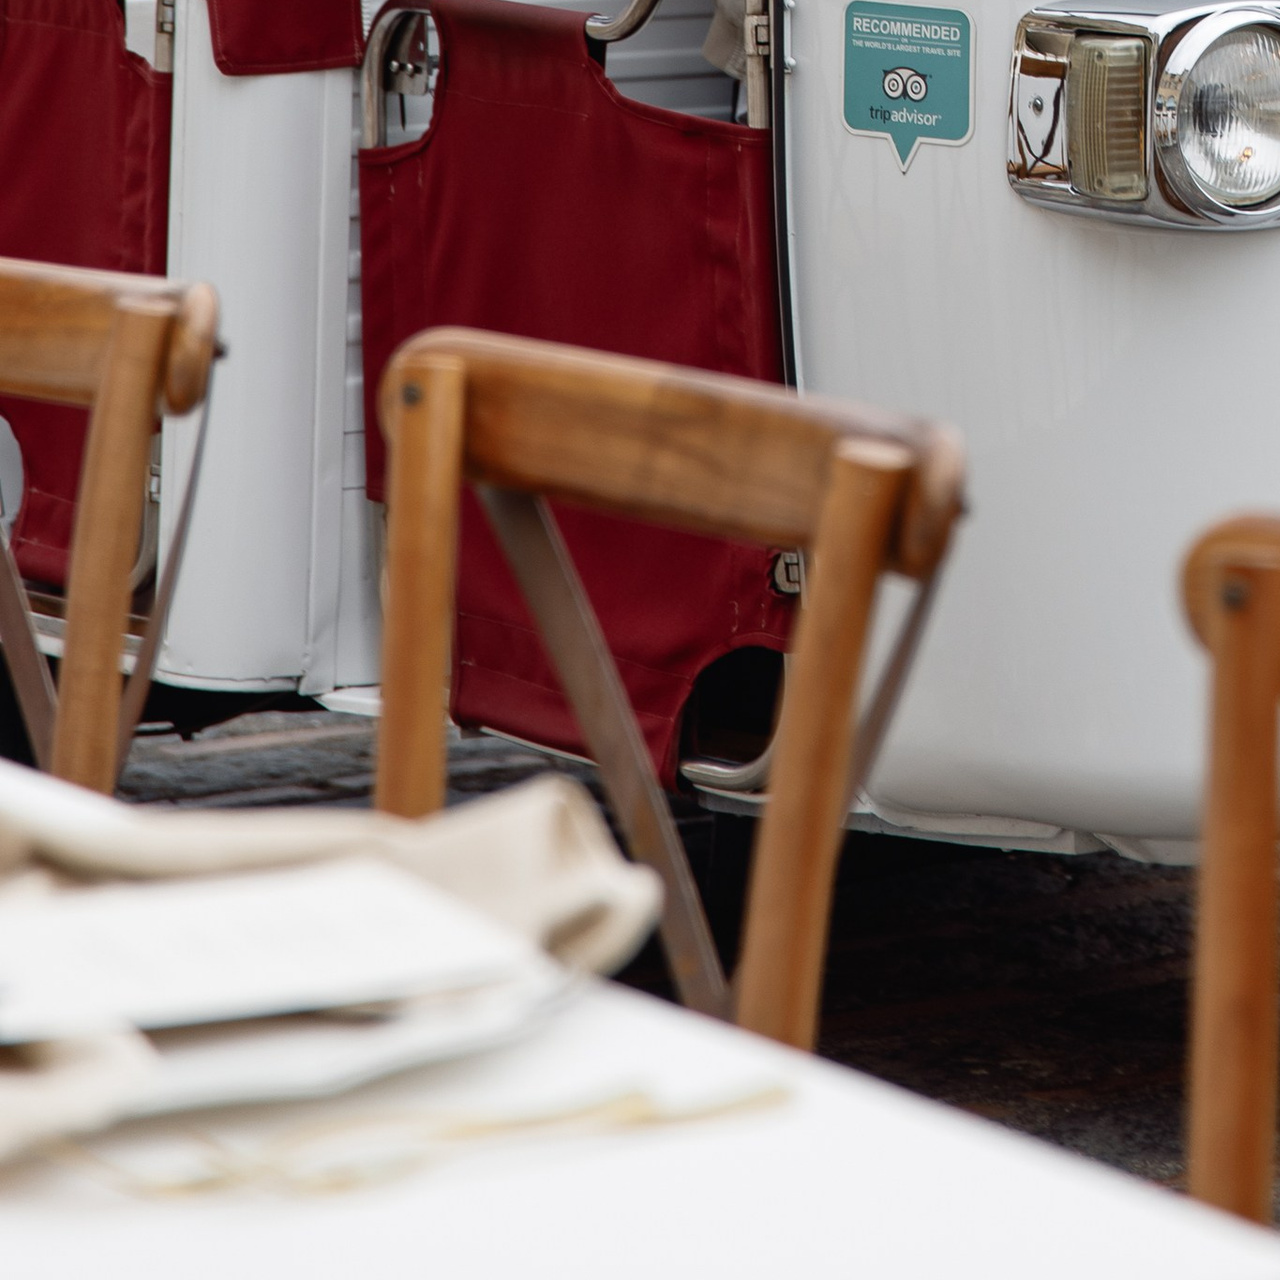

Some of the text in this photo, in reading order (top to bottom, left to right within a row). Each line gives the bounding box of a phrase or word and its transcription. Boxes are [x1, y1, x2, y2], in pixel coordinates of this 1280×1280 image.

[853, 17, 961, 41] RECOMMENDED
[852, 39, 961, 57] THE WORLD'S LARGEST TRAVEL SITE
[869, 105, 939, 127] tripadvisor
